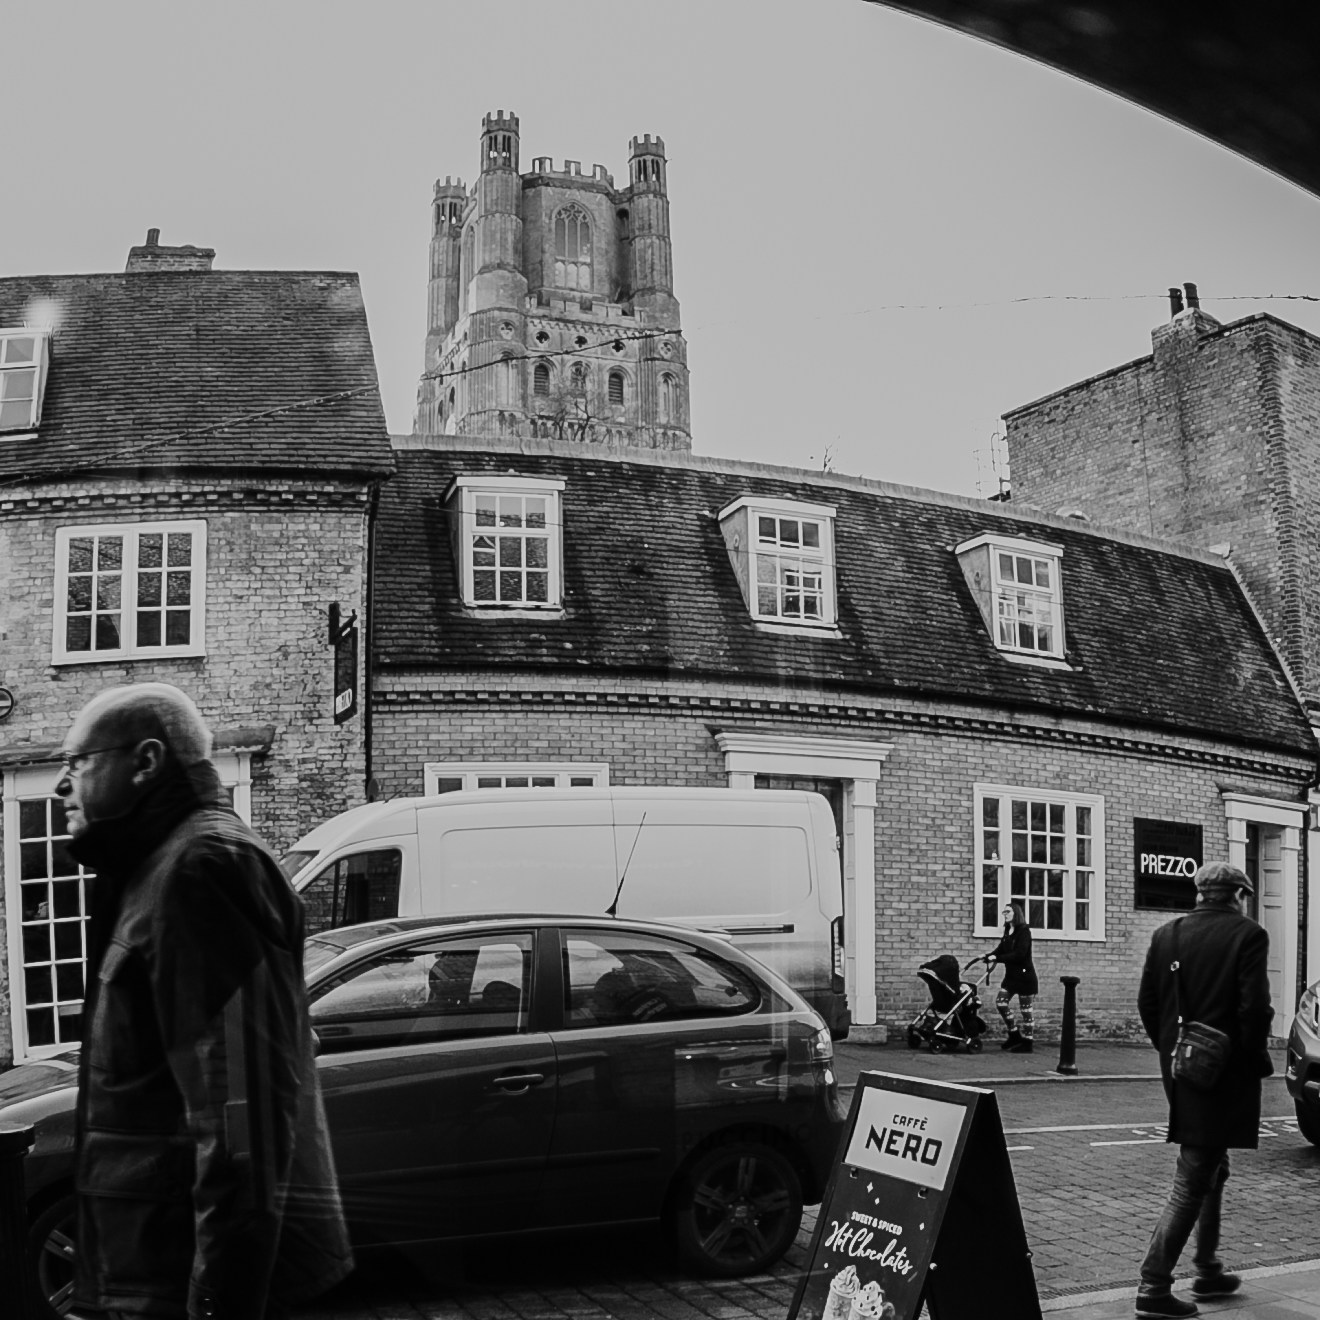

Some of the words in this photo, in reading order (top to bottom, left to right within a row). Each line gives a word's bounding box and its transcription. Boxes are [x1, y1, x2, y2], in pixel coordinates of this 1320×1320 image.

[1140, 853, 1198, 878] PREZZO
[892, 1113, 929, 1131] CAFFÈ
[864, 1124, 944, 1167] NERO
[851, 1210, 874, 1226] SWEET
[878, 1219, 903, 1236] SPICED
[824, 1220, 854, 1253] Hot
[848, 1227, 914, 1276] Chocolates
